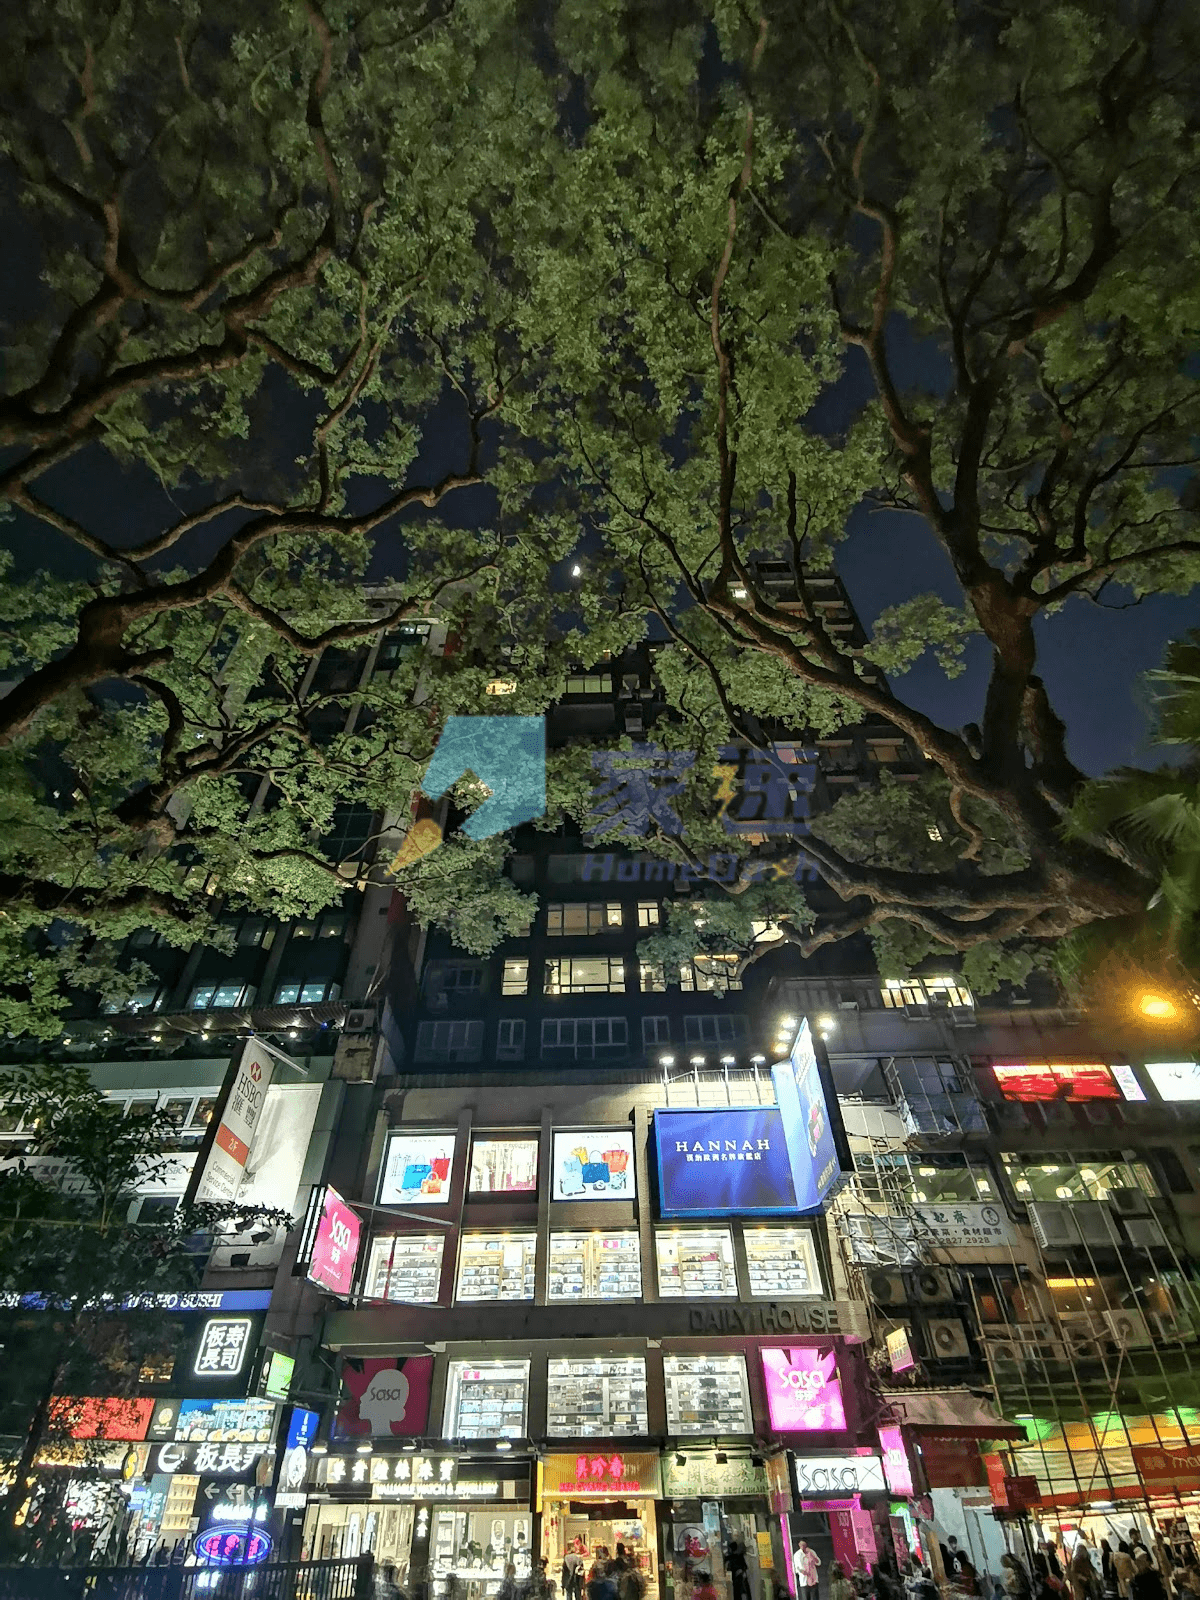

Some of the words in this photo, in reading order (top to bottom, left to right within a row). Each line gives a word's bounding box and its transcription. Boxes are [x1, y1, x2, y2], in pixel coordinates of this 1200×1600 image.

[237, 1071, 262, 1109] HSBC
[675, 1139, 770, 1152] HANNAH
[180, 1293, 224, 1308] SUSHI
[760, 1304, 839, 1330] HOUSE
